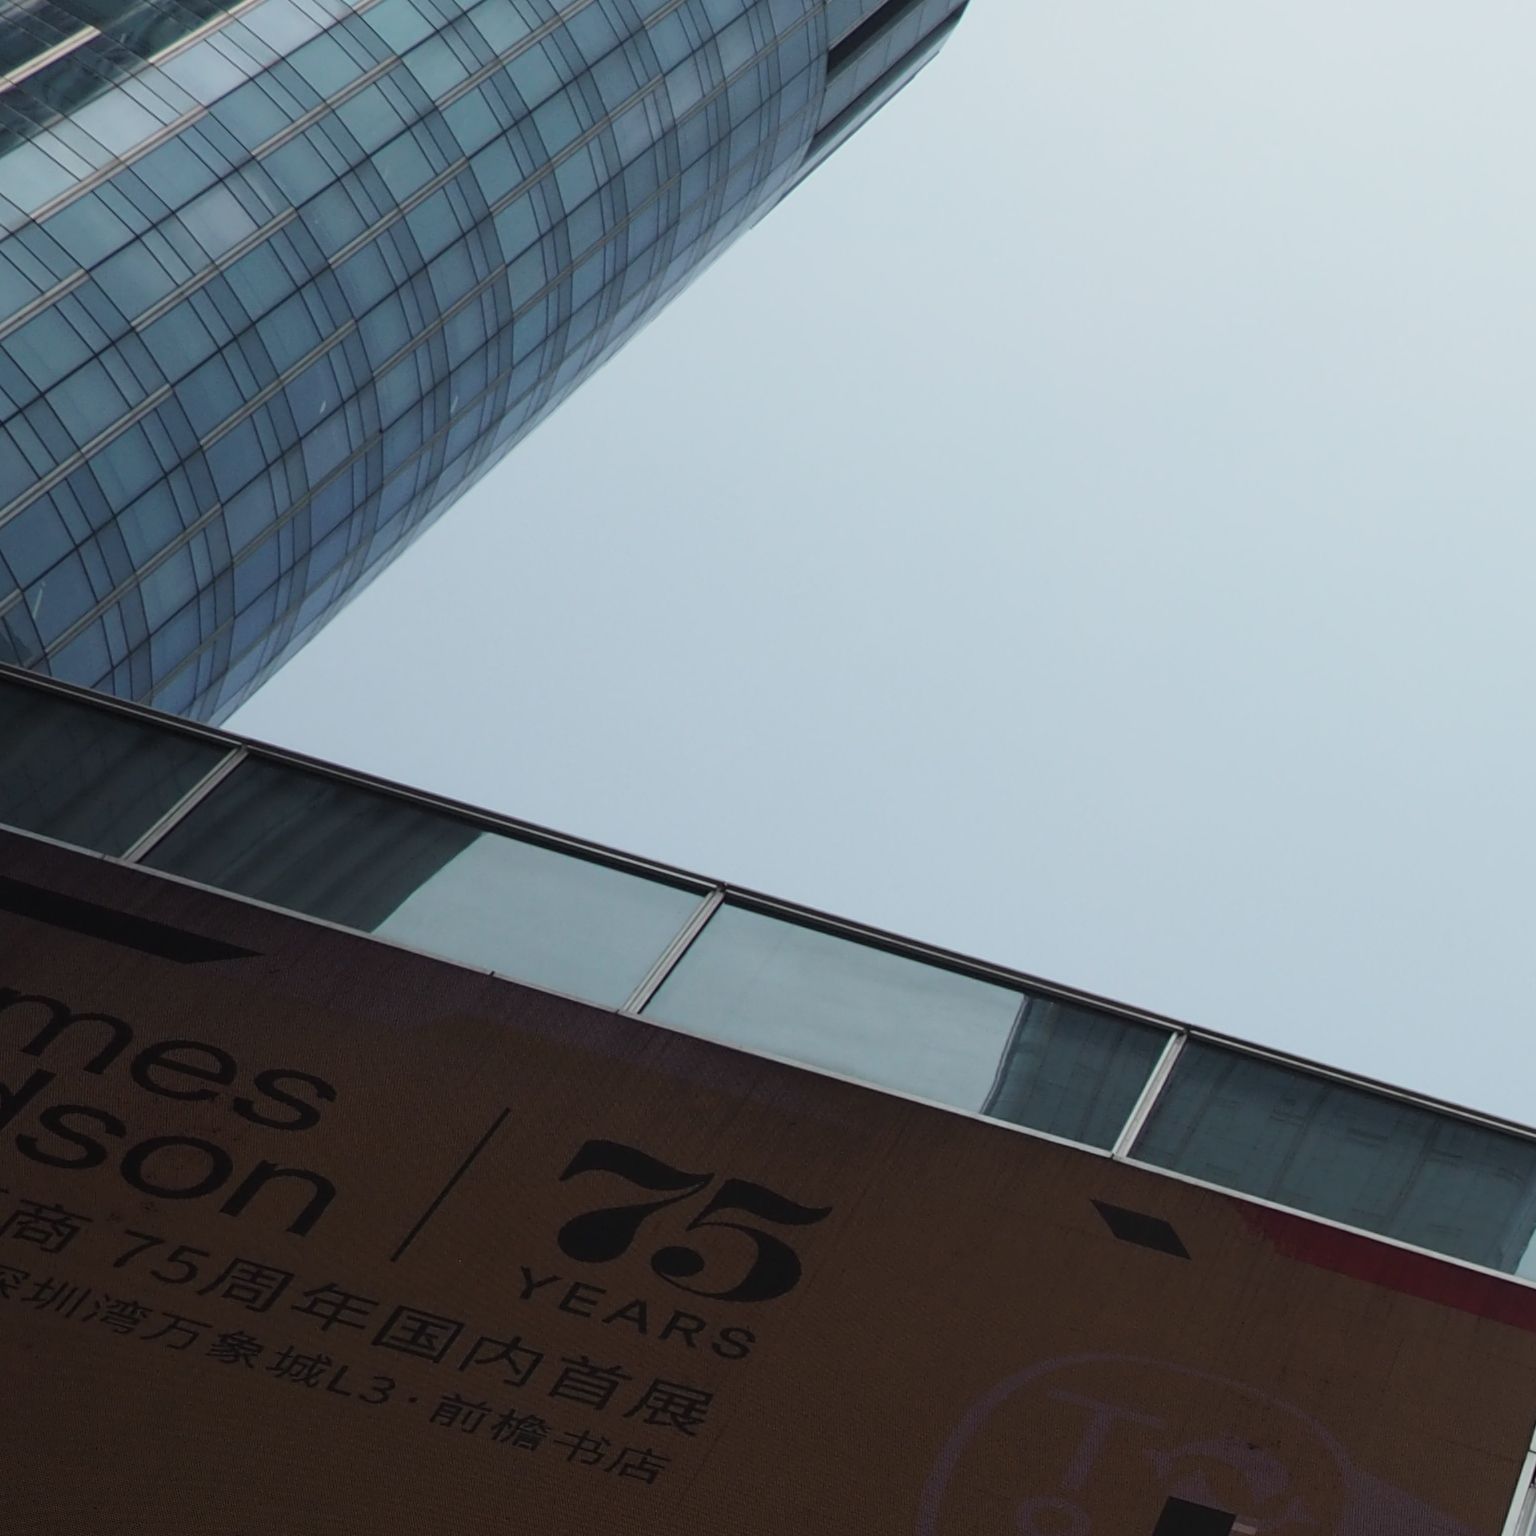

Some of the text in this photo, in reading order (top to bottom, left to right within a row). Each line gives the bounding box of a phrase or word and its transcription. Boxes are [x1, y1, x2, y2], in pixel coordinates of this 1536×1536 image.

[557, 1139, 833, 1303] 75
[0, 1186, 714, 1437] 商 75周年国内首展
[519, 1266, 756, 1360] YEARS
